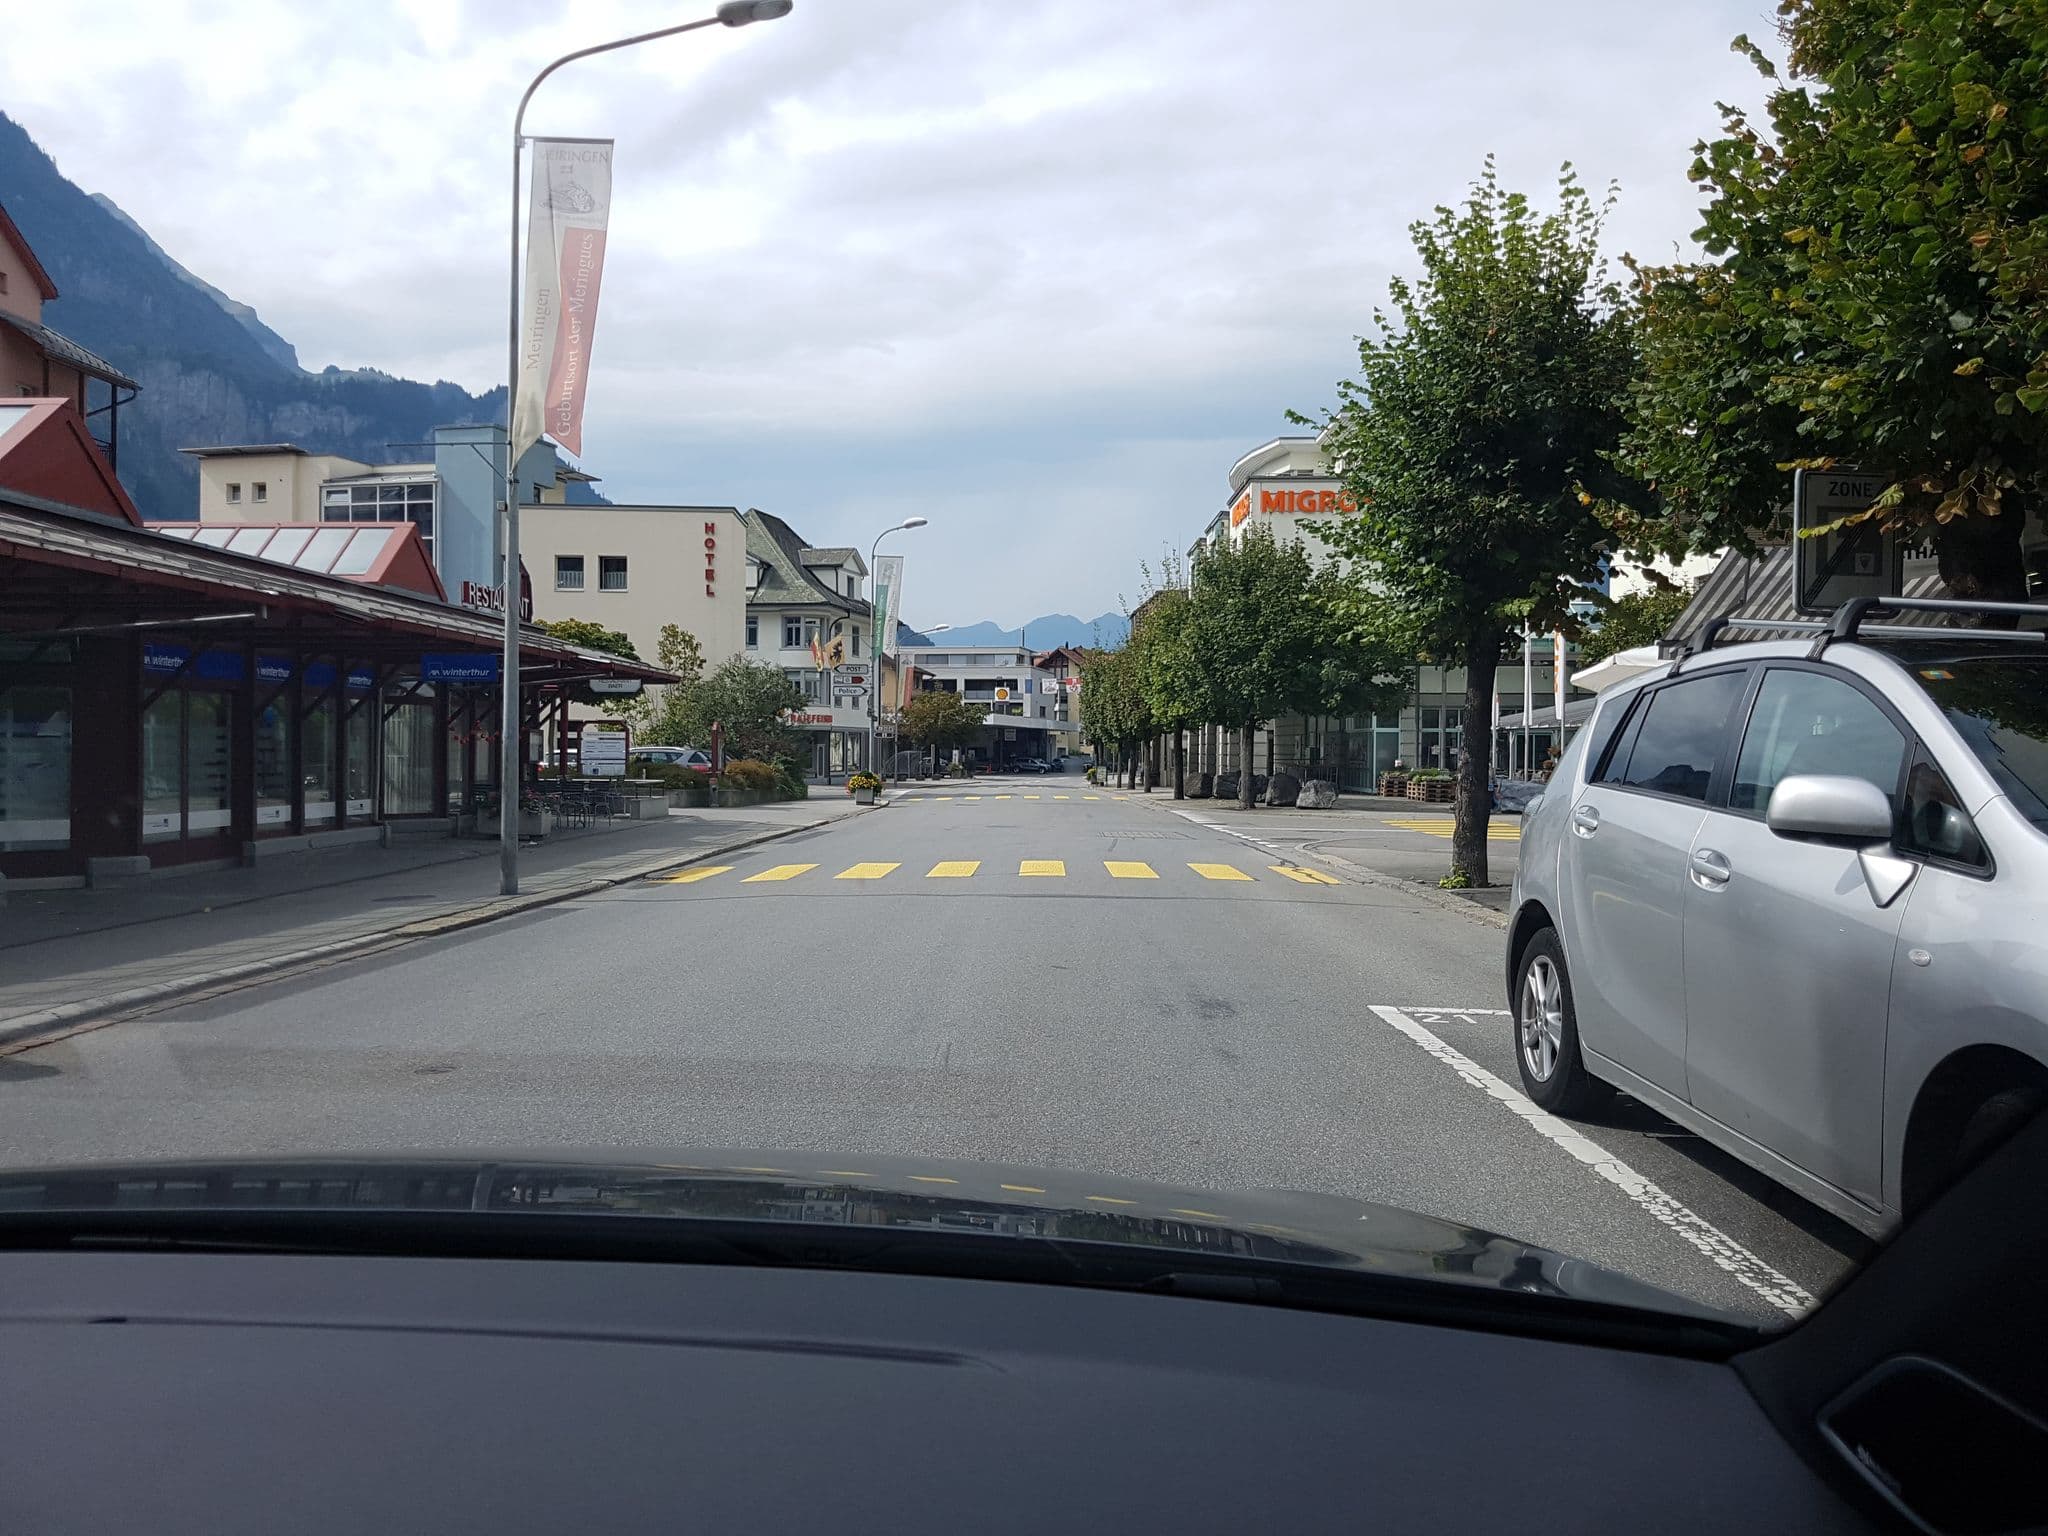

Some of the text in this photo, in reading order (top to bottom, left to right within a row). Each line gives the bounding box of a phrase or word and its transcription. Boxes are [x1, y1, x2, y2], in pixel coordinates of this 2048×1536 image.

[526, 288, 552, 370] Meiringen
[556, 233, 594, 437] Geburtsort der Meringues
[1261, 490, 1373, 513] MIGRO
[1828, 481, 1874, 497] ZONE
[704, 522, 716, 598] HOTEL
[468, 582, 530, 620] RESTAUNT
[442, 668, 490, 677] winterthur
[1413, 1012, 1478, 1025] 21
